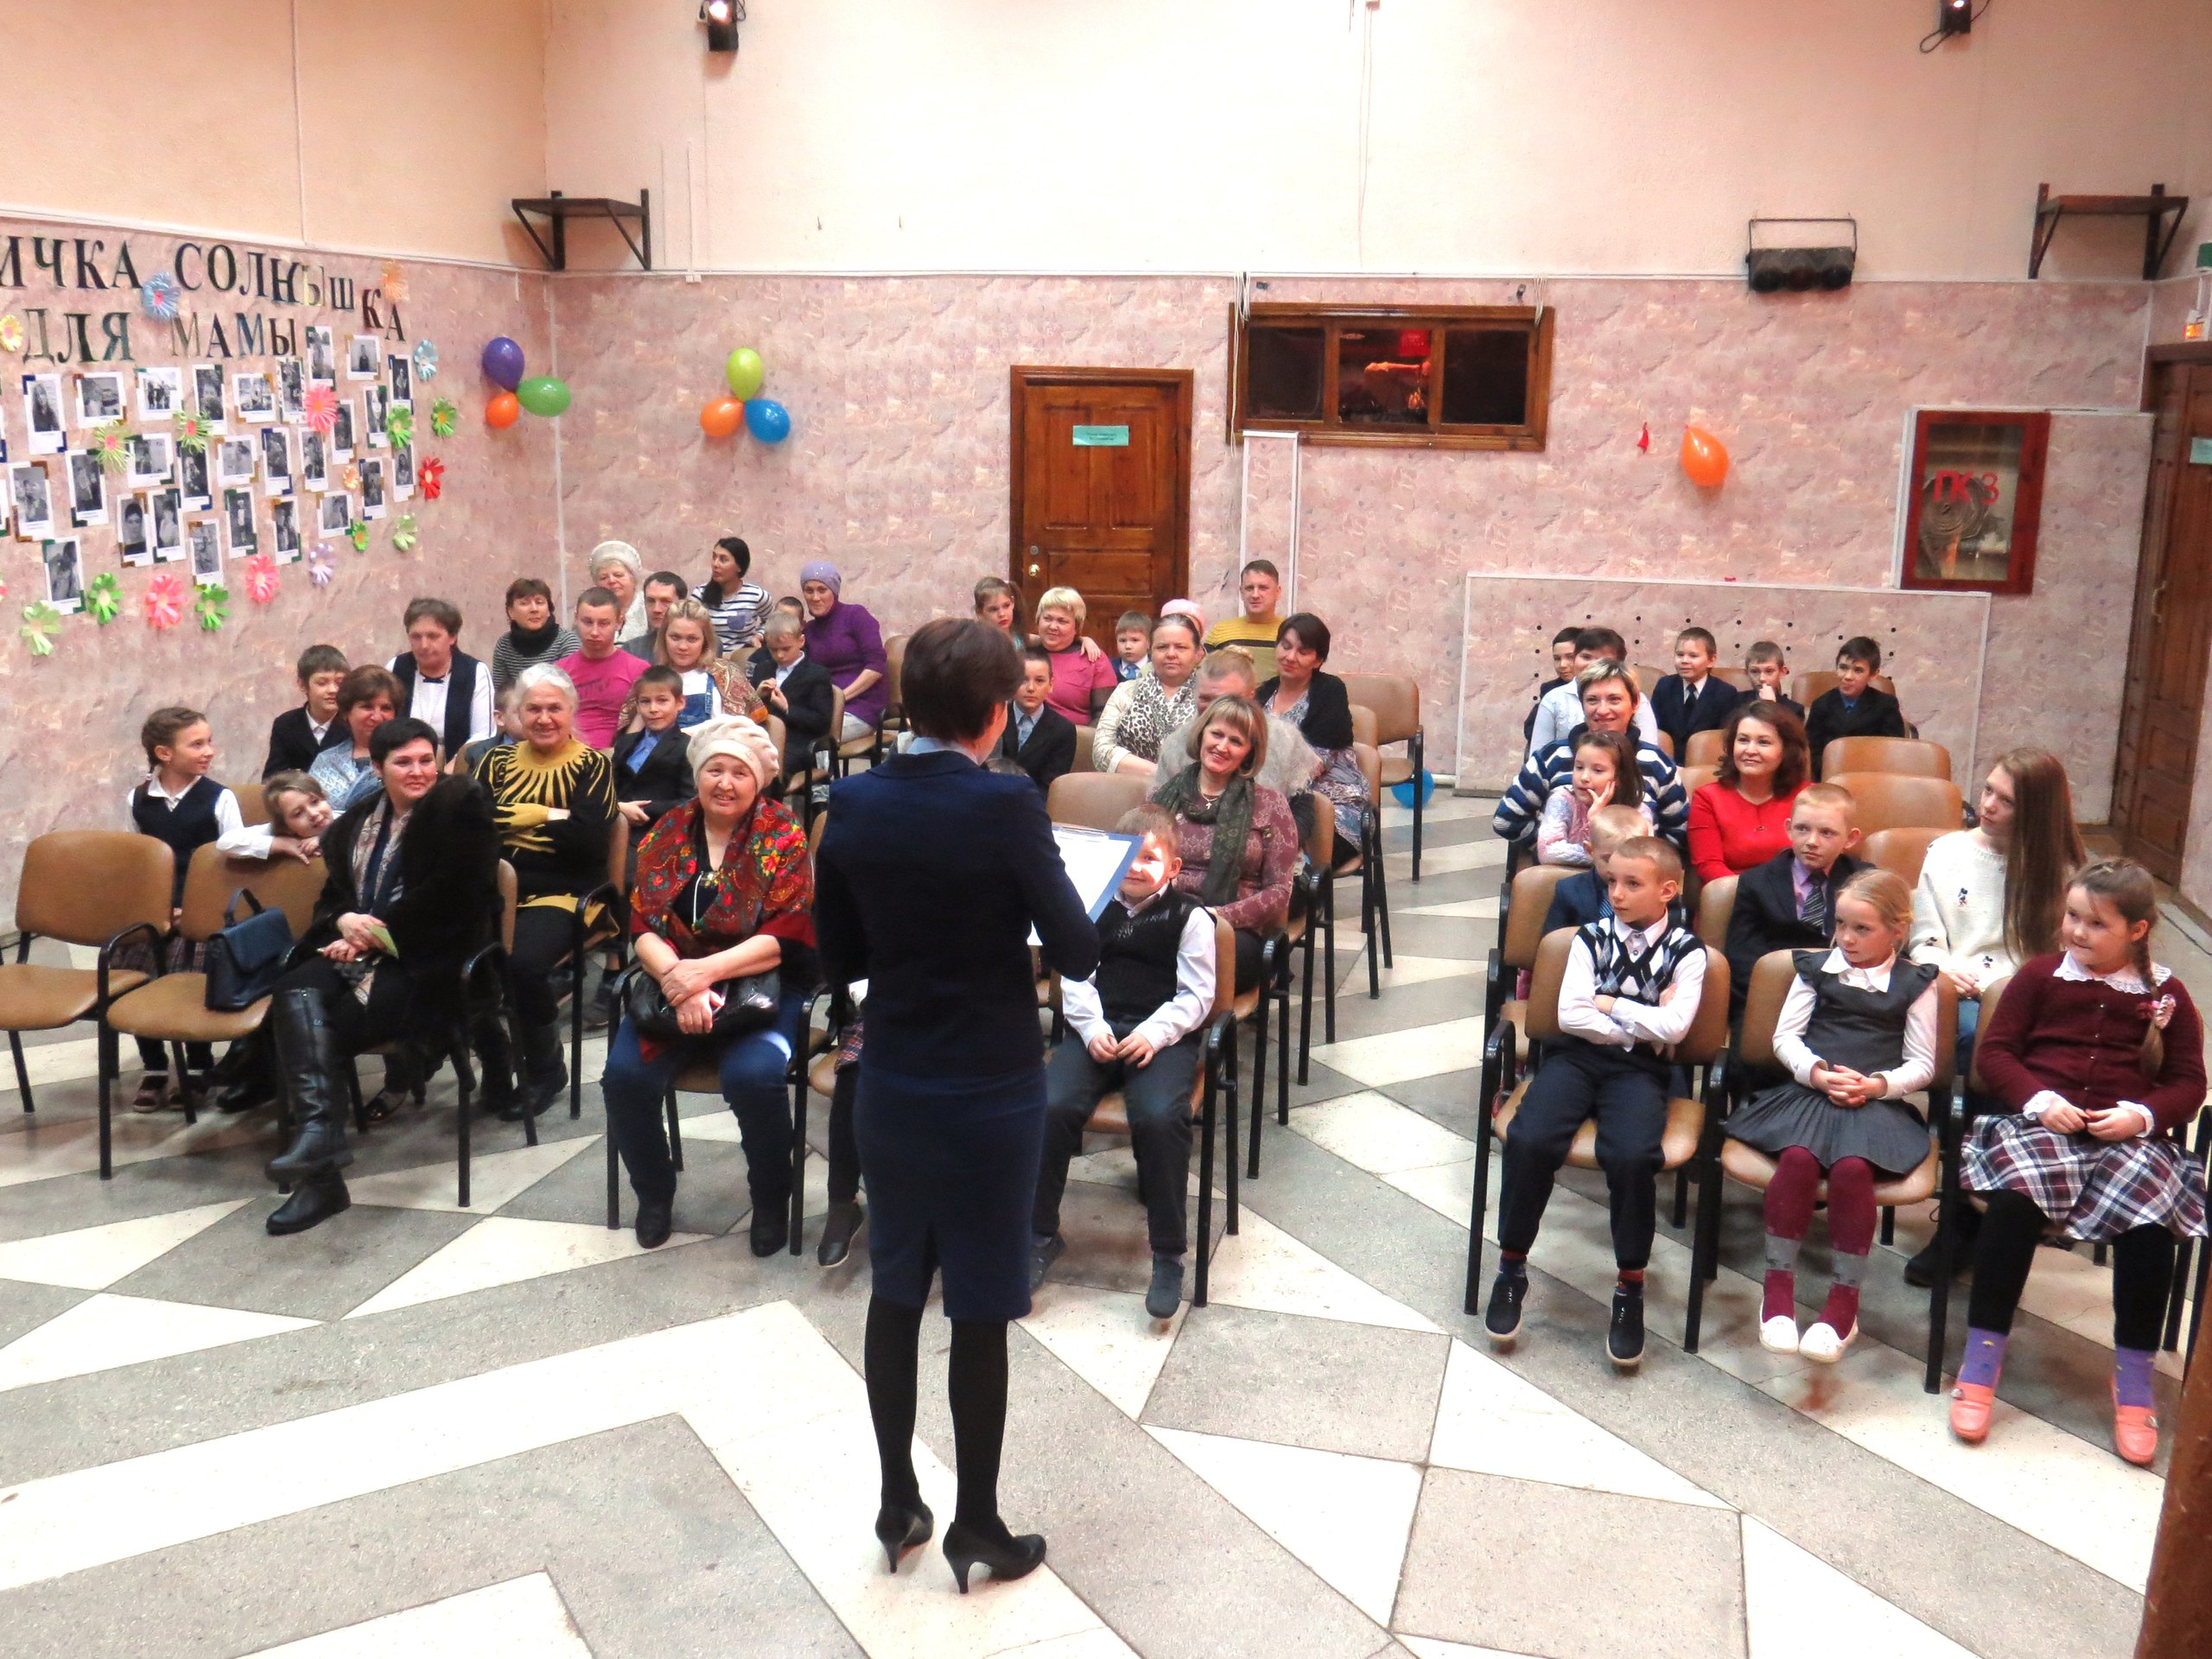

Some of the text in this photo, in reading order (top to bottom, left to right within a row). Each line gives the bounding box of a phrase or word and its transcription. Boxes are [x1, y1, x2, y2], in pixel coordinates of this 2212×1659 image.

[175, 243, 406, 341] СОЛНЫШКА
[22, 308, 296, 365] ДЛЯ МАМЫ
[1934, 470, 1999, 504] ПК 3
